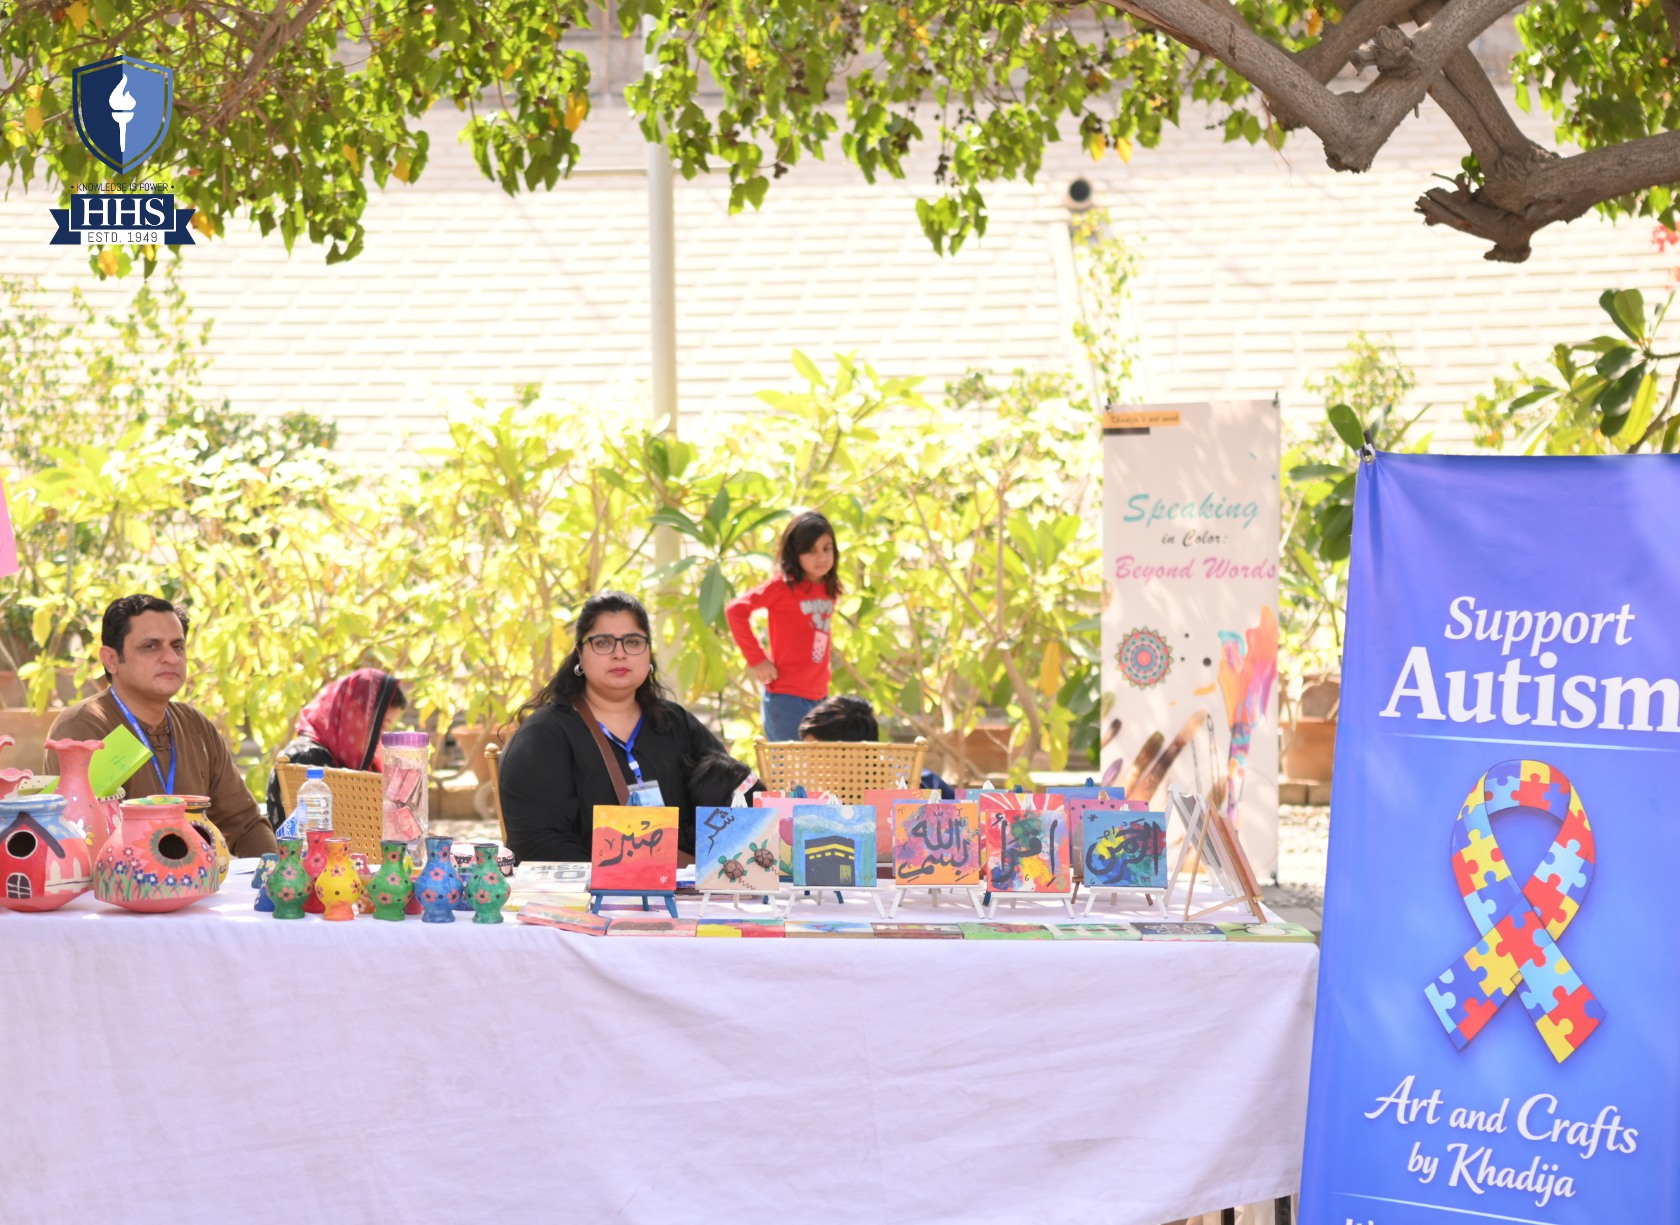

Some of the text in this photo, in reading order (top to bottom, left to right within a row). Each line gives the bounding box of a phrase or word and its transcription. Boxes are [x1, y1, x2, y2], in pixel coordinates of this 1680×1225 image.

[1123, 491, 1260, 528] Speaking
[1161, 529, 1228, 547] in Color:
[1114, 554, 1277, 586] Beyond Words
[1444, 595, 1636, 658] Support
[1378, 645, 1680, 733] Autism
[1364, 1075, 1639, 1160] Art and Crafts
[1407, 1141, 1576, 1208] by Khadija
